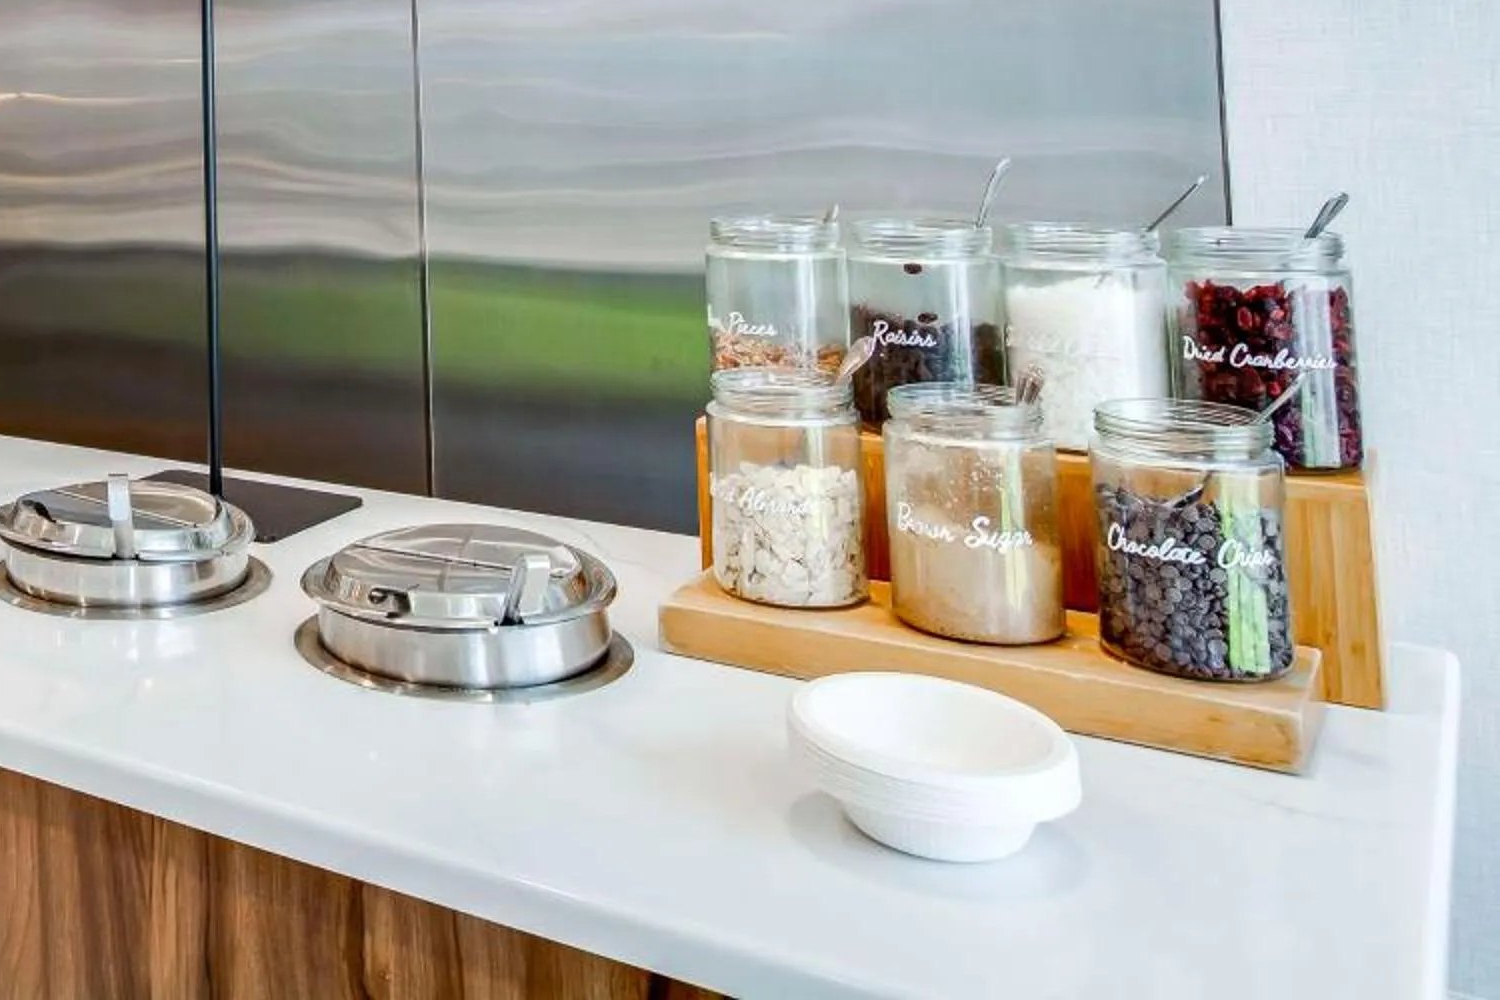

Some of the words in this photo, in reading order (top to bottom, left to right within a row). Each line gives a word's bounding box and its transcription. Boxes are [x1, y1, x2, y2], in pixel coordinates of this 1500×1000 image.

[728, 311, 778, 337] Pieces
[871, 319, 937, 348] Raisins
[1182, 335, 1225, 363] Dried
[1229, 343, 1338, 369] Cranberries
[739, 487, 819, 517] Almond
[897, 501, 955, 543] Brown
[963, 515, 1034, 554] Sugar
[1107, 522, 1207, 565] Chocolate
[1217, 538, 1277, 569] Chips
